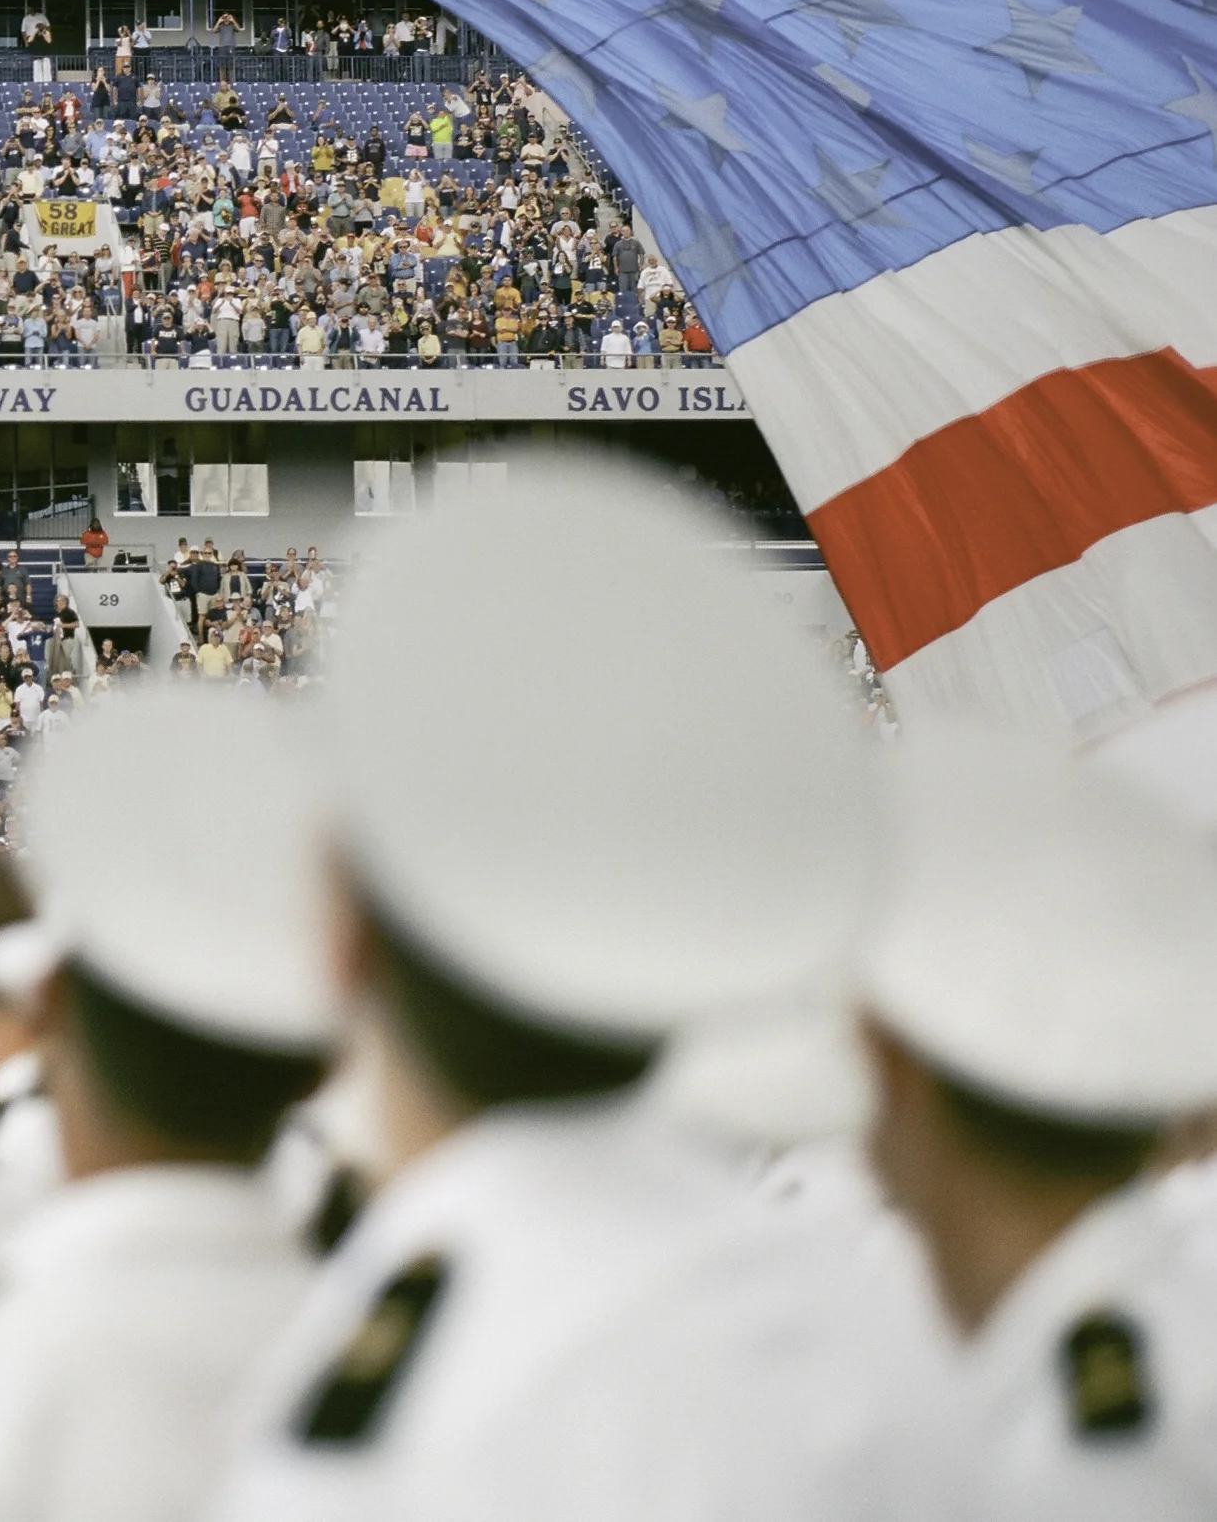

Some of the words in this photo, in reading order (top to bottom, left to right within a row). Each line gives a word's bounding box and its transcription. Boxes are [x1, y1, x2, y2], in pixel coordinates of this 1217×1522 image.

[49, 203, 78, 220] 58
[51, 220, 95, 236] GREAT
[587, 256, 601, 270] 12
[184, 387, 450, 412] GUADALCANAL
[567, 386, 660, 412] SAVO
[98, 593, 120, 607] 29
